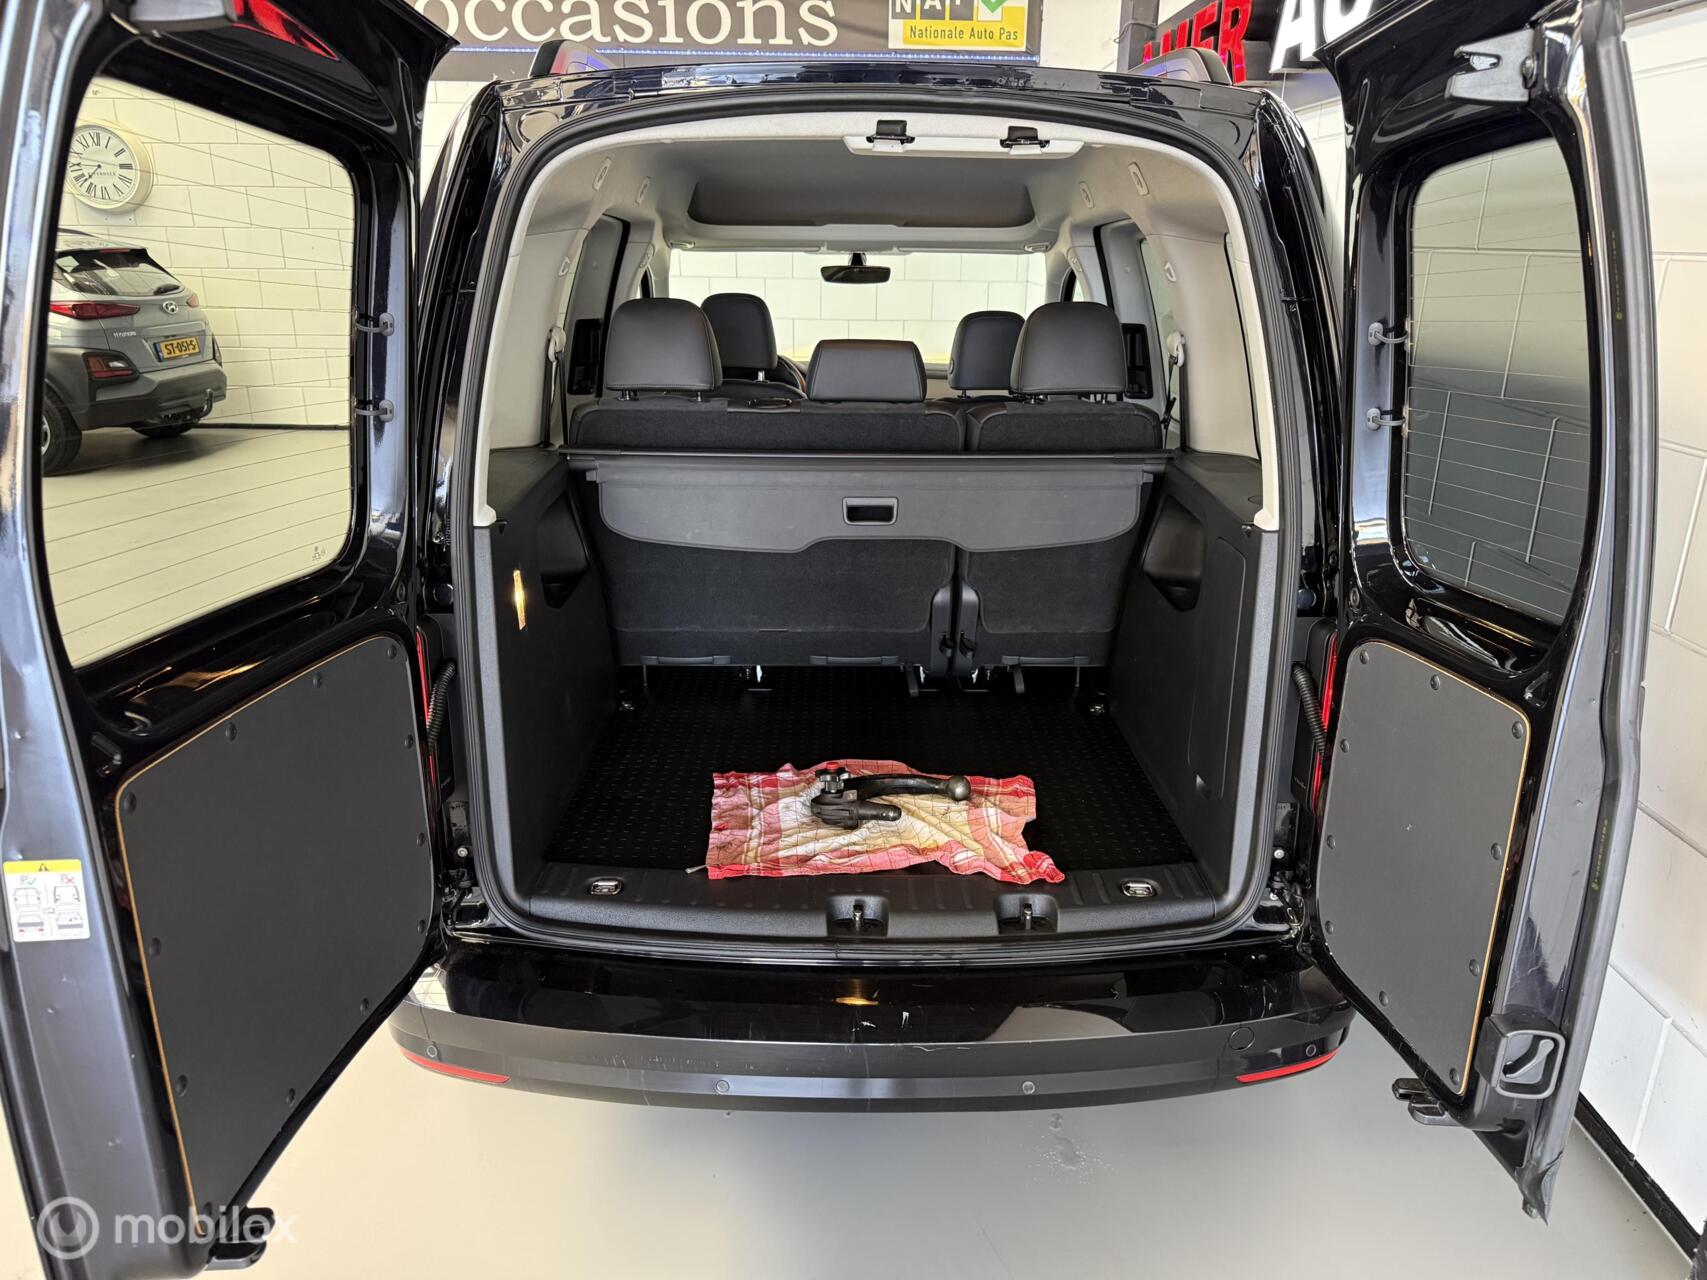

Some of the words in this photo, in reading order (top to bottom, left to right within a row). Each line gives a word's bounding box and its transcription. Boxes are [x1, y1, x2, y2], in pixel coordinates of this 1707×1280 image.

[895, 0, 963, 13] NA
[414, 0, 838, 47] occasions
[910, 25, 964, 39] Nationale
[969, 27, 994, 40] Auto
[1000, 27, 1018, 41] Pas
